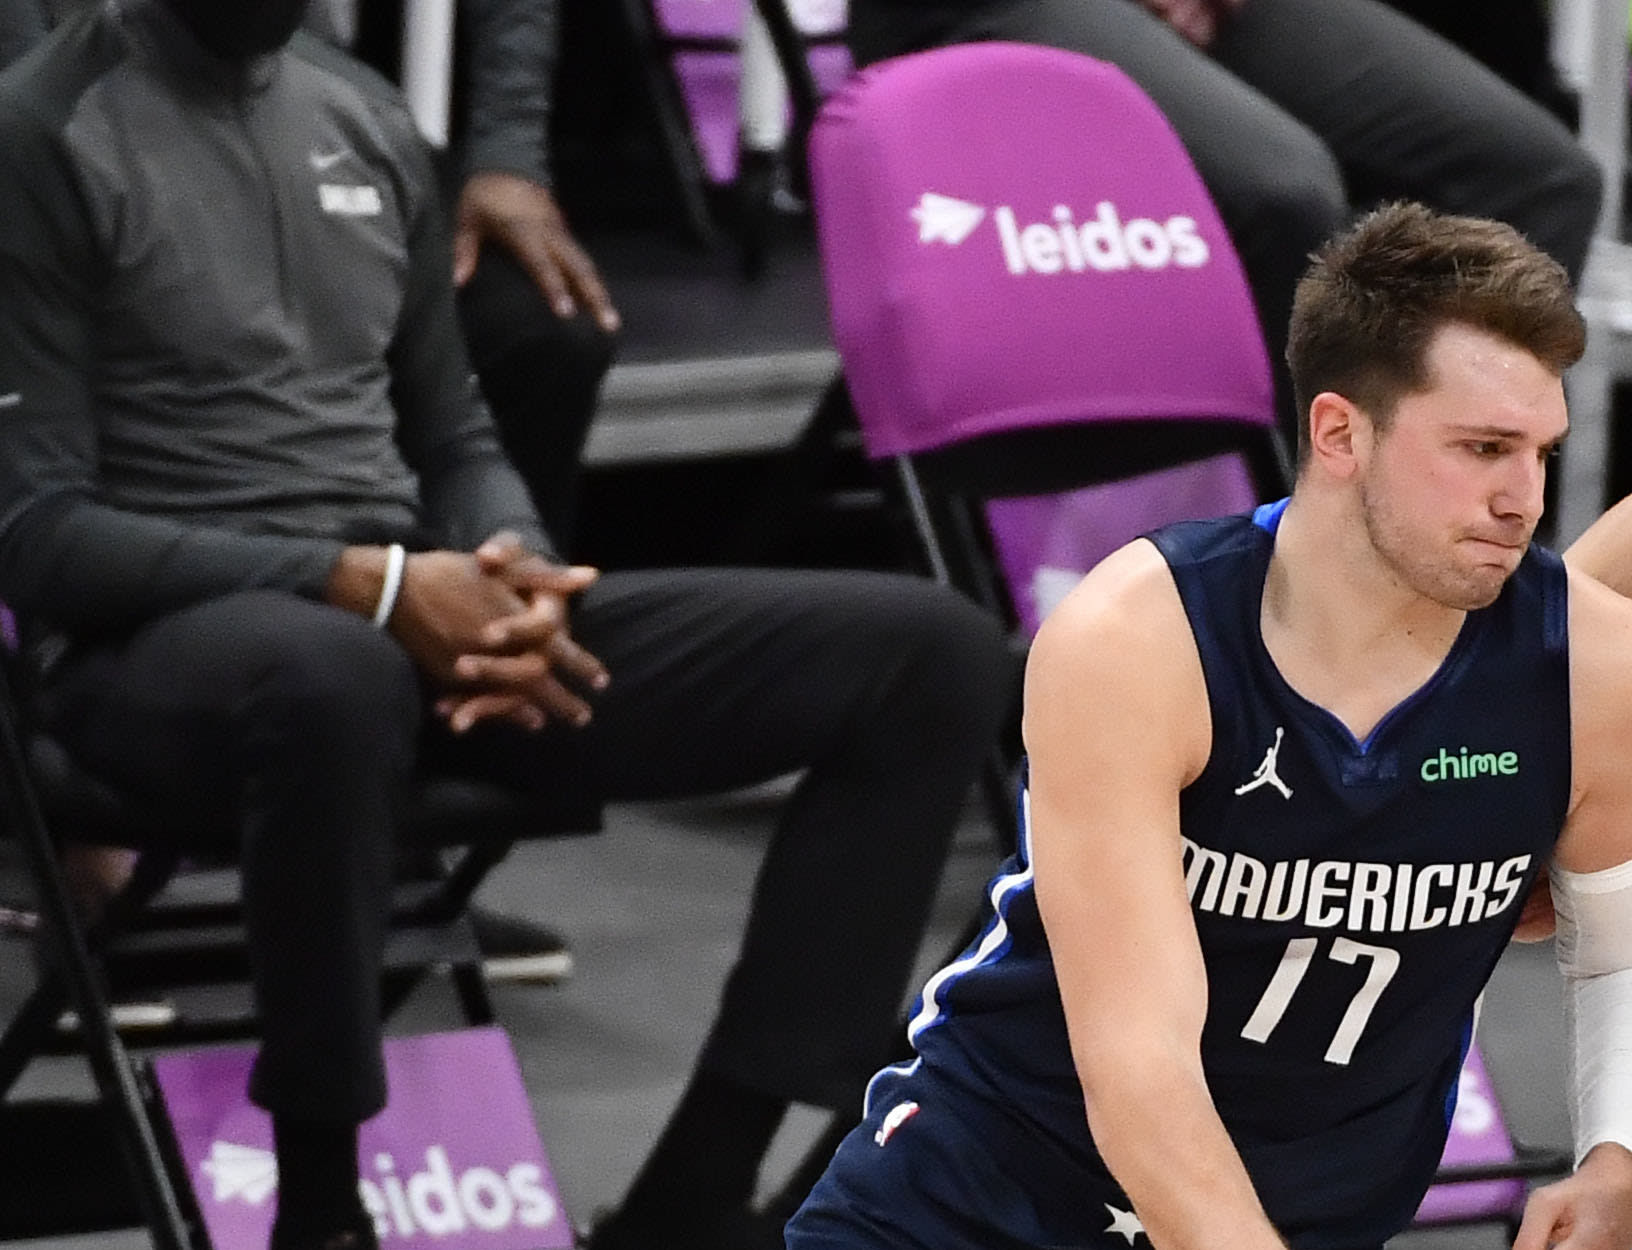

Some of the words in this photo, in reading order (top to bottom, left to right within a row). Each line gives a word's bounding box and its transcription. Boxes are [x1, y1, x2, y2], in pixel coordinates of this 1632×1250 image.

[995, 200, 1208, 275] leidos
[1420, 746, 1519, 782] chime
[1181, 835, 1531, 932] MAVERICKS
[1240, 936, 1401, 1065] 17
